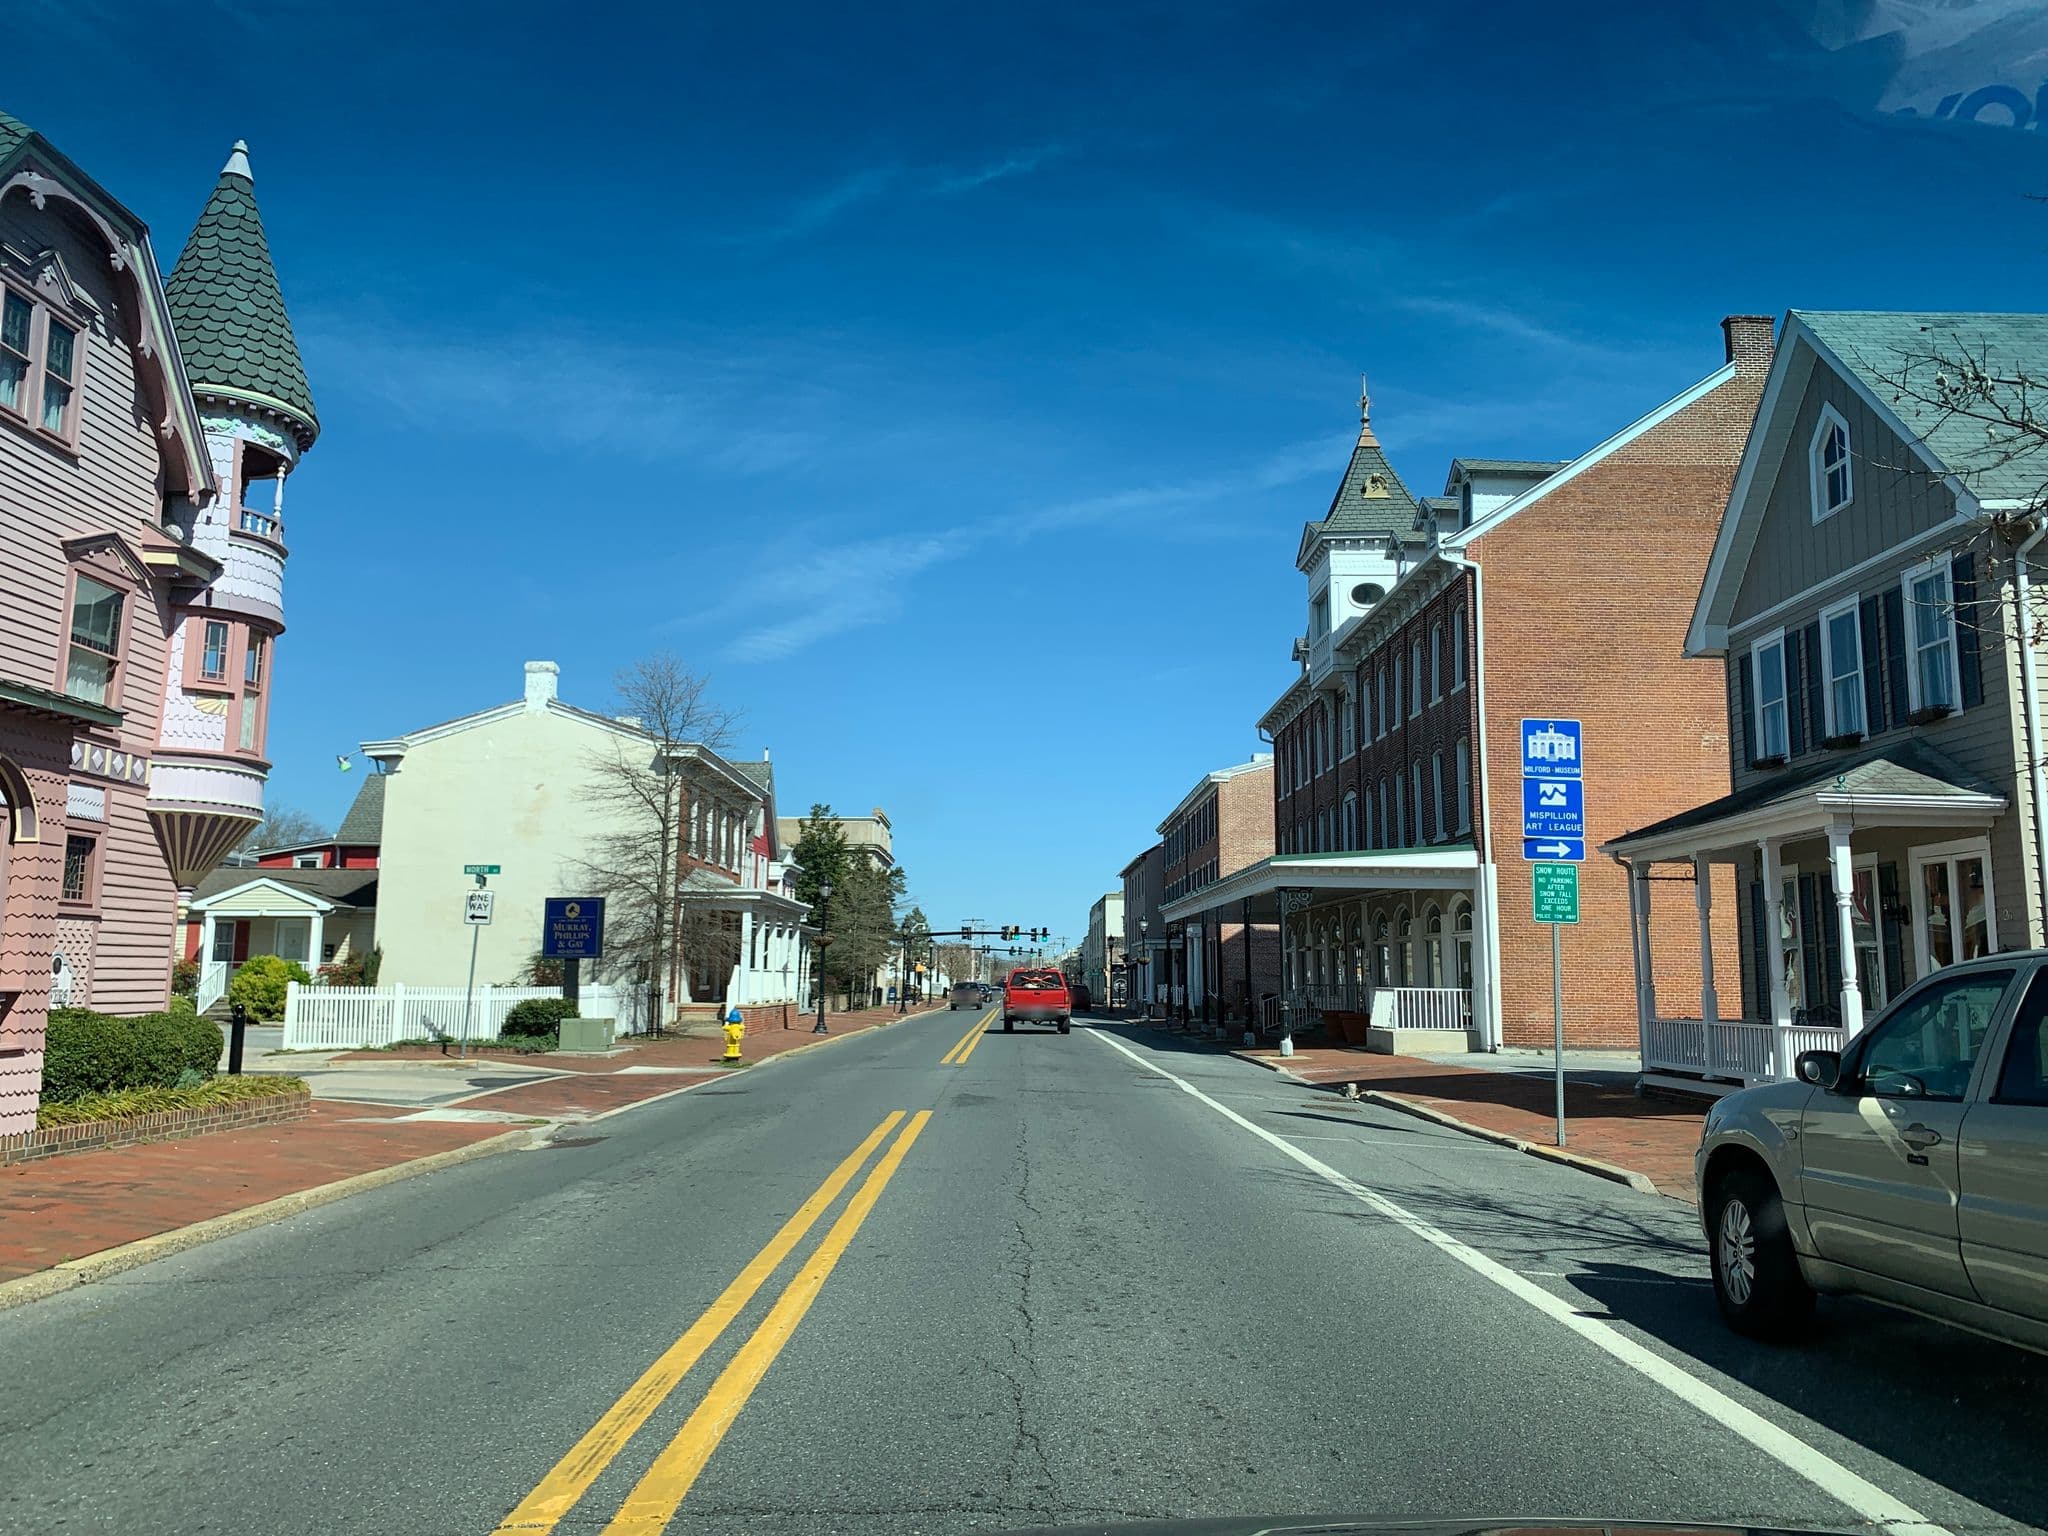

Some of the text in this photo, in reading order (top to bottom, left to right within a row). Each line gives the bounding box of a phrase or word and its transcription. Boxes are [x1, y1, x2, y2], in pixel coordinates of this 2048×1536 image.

[1525, 765, 1580, 774] MILFORD MUSEUM
[1530, 811, 1578, 820] MISPILLION
[1549, 823, 1582, 832] LEAGUE
[1556, 868, 1575, 876] ROUTE
[470, 893, 488, 902] ONE
[469, 903, 488, 911] WAY
[557, 940, 565, 948] &
